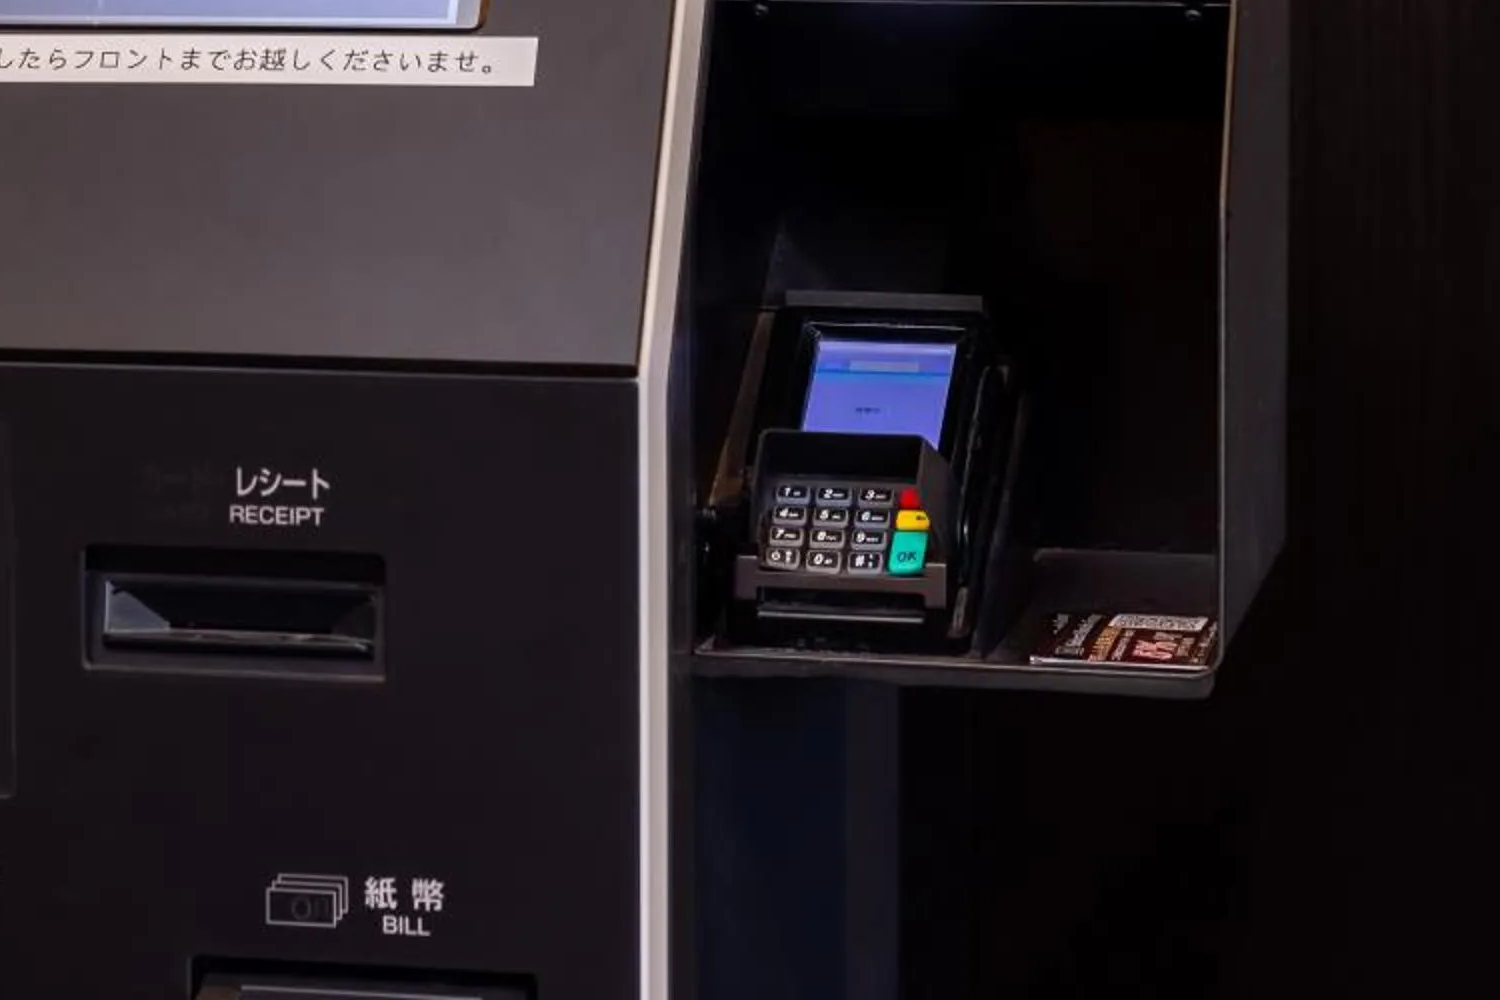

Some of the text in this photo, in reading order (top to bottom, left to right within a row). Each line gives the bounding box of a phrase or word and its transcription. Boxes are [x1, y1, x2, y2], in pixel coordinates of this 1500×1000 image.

[236, 466, 331, 500] レシート
[229, 504, 325, 526] RECEIPT
[896, 551, 917, 562] OK
[364, 876, 444, 912] 紙幣
[382, 915, 431, 937] BILL
